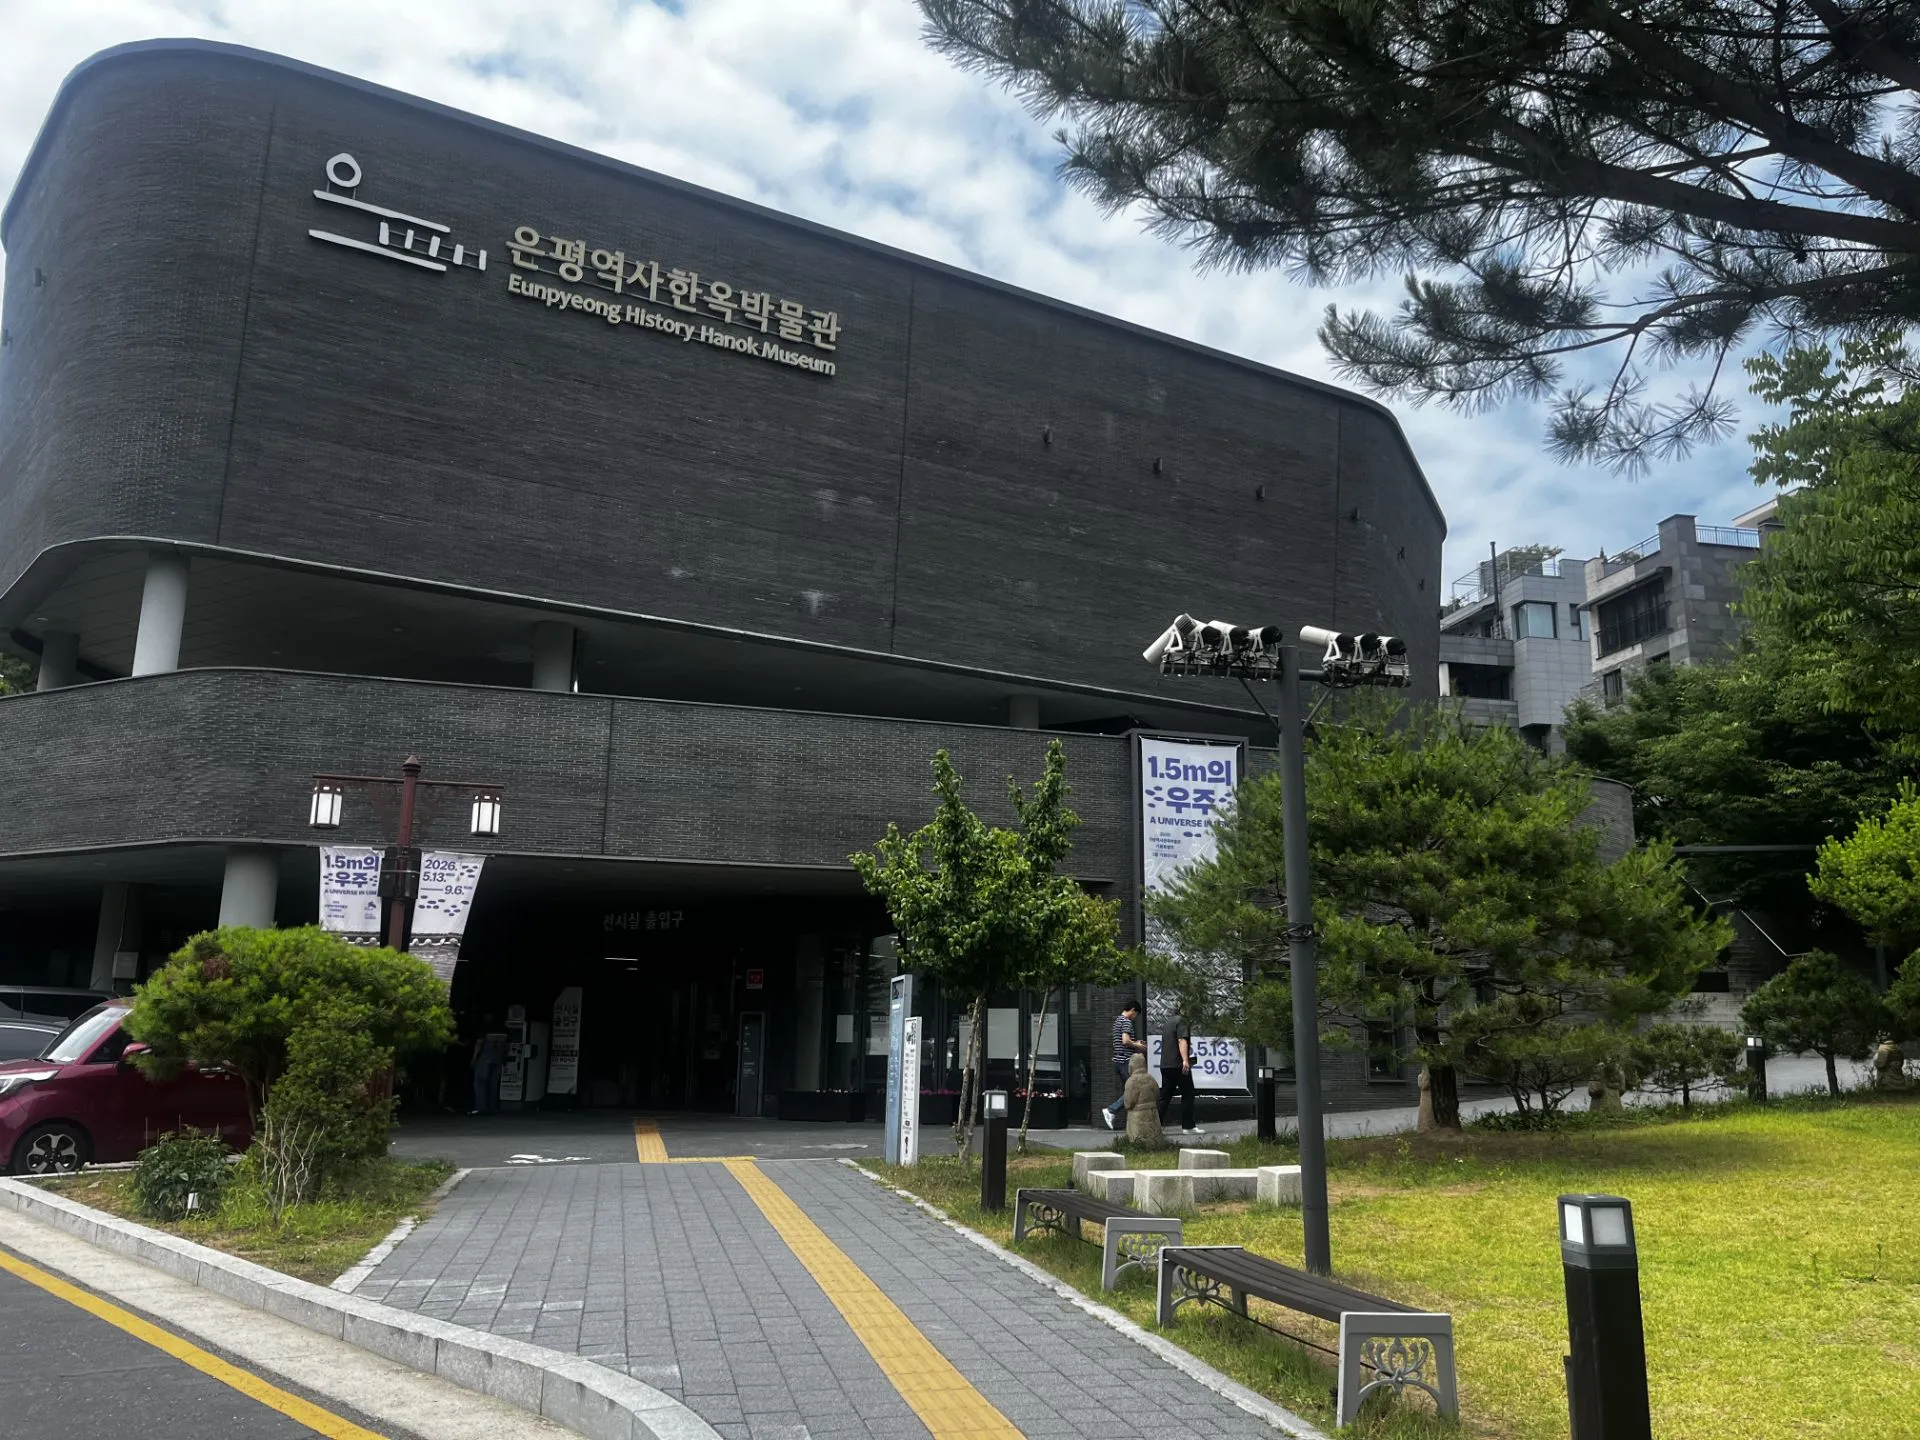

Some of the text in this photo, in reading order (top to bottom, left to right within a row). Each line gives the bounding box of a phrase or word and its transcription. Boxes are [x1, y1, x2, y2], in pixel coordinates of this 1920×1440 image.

[506, 226, 842, 350] 은평역사한옥박물관
[507, 274, 836, 376] Eunpyeong History Hanok Museum
[1148, 755, 1232, 786] 1.5m의
[1166, 787, 1216, 815] 우주
[1150, 816, 1156, 824] A
[1158, 817, 1202, 828] UNIVERSE
[324, 854, 380, 872] 1.5m의
[424, 859, 458, 871] 2026.
[335, 871, 368, 888] 우주
[602, 909, 685, 932] 전시실 출입구
